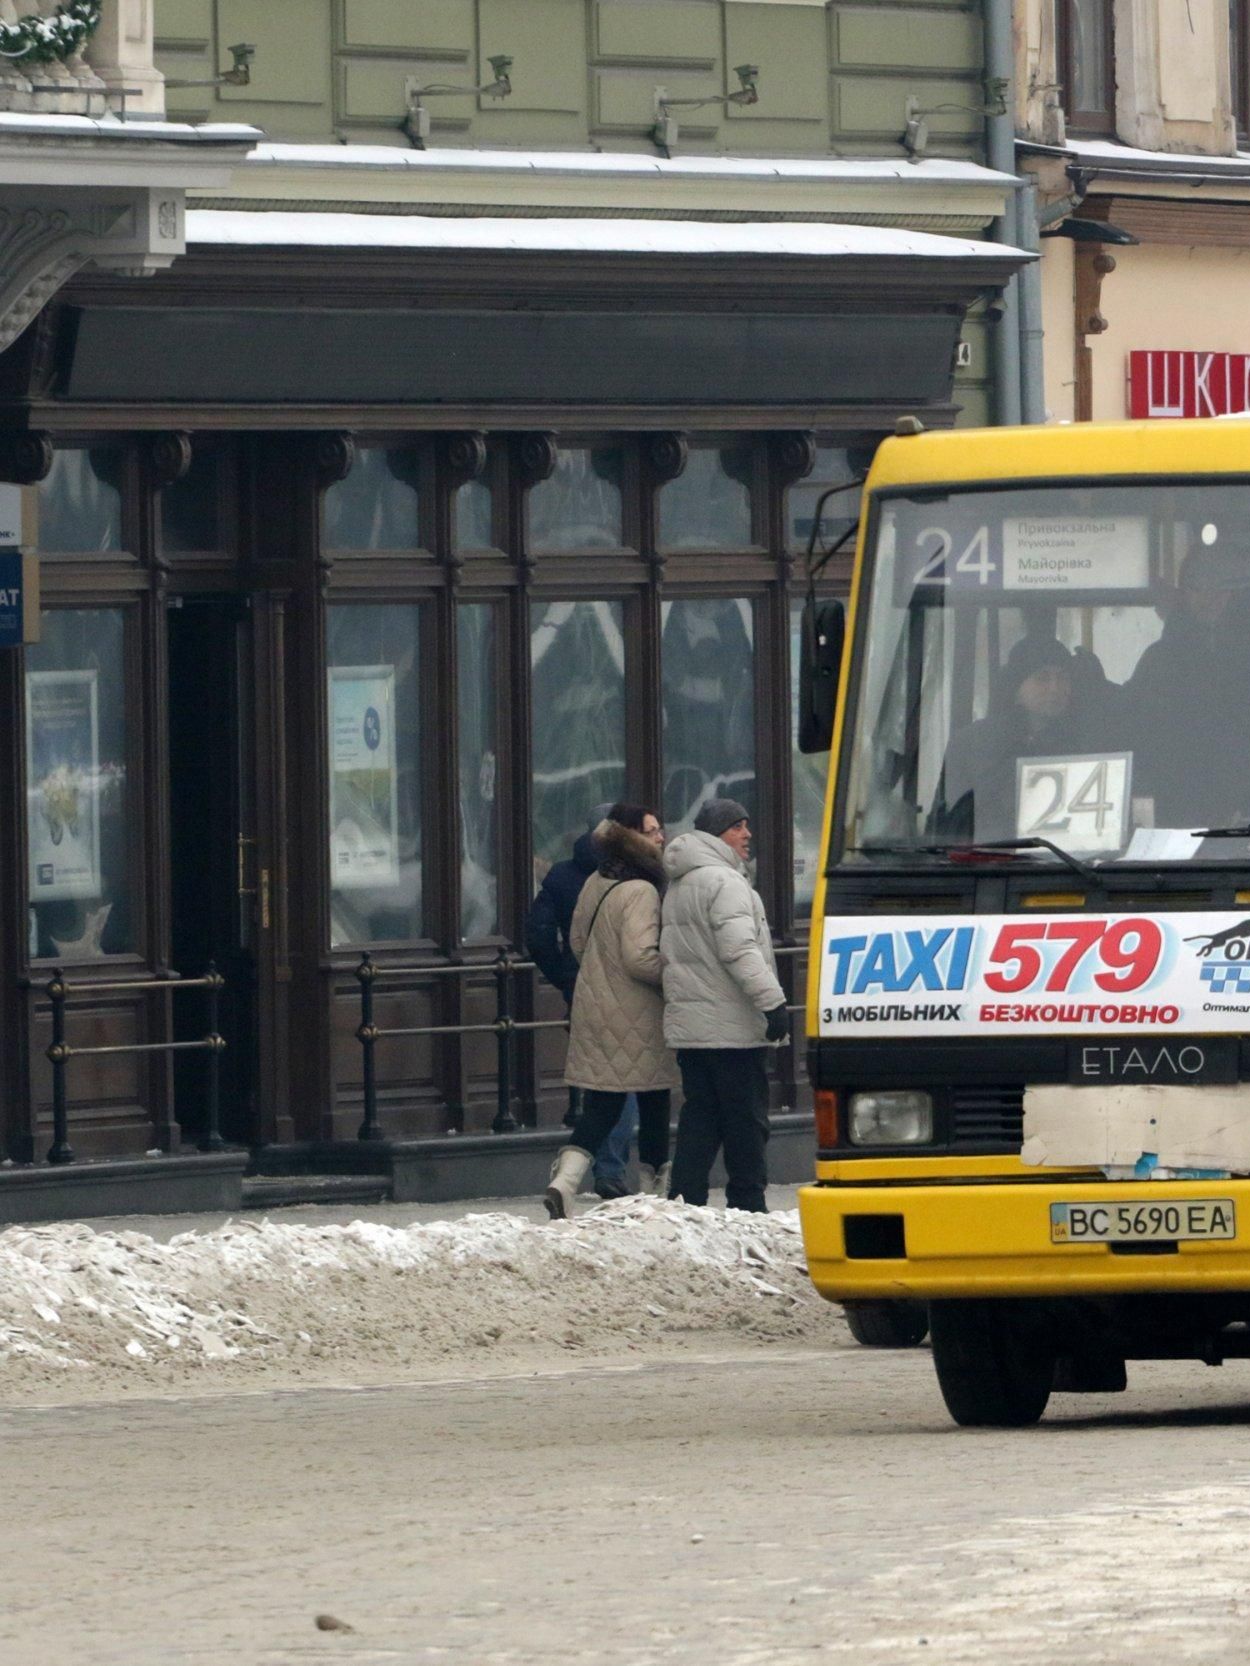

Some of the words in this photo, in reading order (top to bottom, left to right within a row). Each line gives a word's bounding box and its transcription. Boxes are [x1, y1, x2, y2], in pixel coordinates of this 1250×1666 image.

[1017, 521, 1117, 535] Привокзальна
[912, 525, 997, 586] 24
[1017, 555, 1093, 572] Майорівка
[1026, 761, 1115, 837] 24
[829, 926, 976, 996] TAXI
[983, 917, 1164, 994] 579
[838, 1003, 962, 1023] МОБІЛЬНИХ
[979, 1003, 1181, 1025] БЕЗКОШТОВНО
[1069, 1208, 1110, 1237] BC
[1117, 1206, 1181, 1236] 5690
[1187, 1204, 1229, 1234] EA
